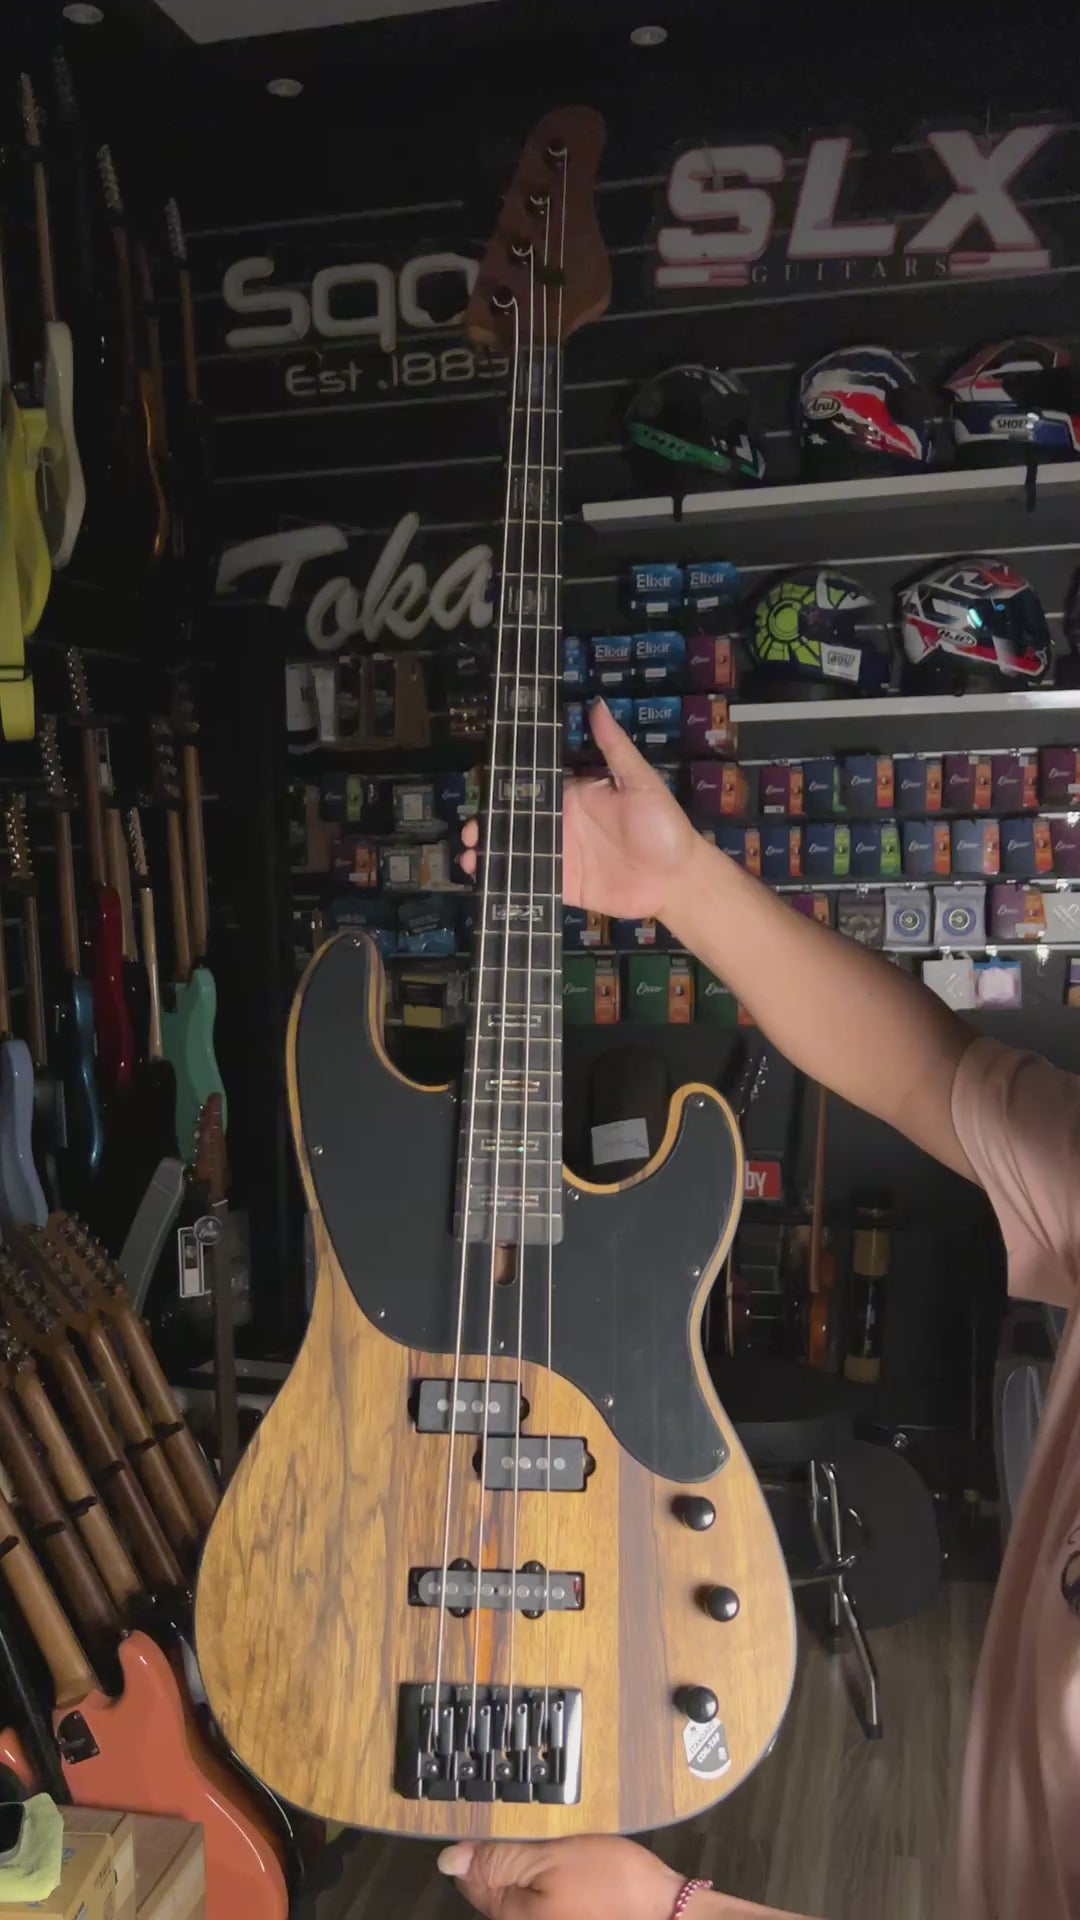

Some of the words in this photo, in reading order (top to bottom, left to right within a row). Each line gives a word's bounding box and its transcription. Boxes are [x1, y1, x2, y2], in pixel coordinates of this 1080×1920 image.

[658, 125, 1056, 264] SLX
[752, 255, 948, 284] GUITARS
[636, 574, 672, 588] Elixir
[690, 572, 725, 586] Elixir
[595, 645, 630, 658] Elixir
[636, 641, 670, 656] Elixir
[638, 706, 673, 720] Elixir
